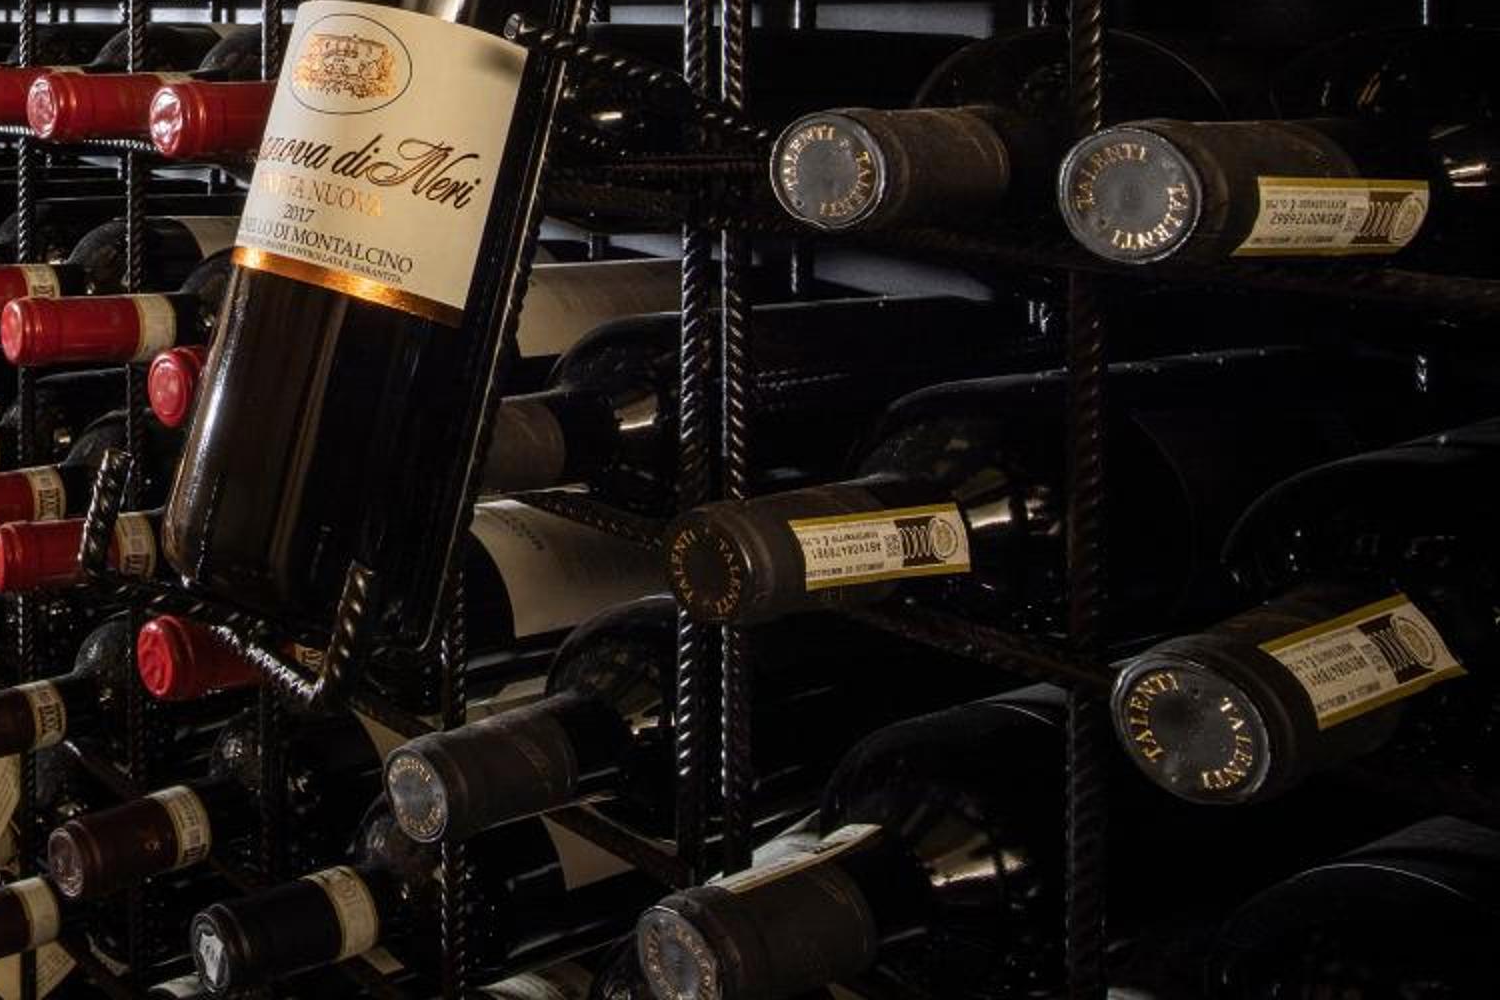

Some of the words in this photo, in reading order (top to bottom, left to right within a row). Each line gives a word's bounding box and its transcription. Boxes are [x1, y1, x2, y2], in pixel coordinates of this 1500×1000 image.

[332, 133, 383, 180] di
[365, 138, 482, 210] Neri
[1076, 143, 1147, 209] TALENTI
[283, 203, 315, 224] 2017
[1111, 182, 1189, 250] TALENTI
[290, 229, 413, 274] MONTALCINO
[1129, 672, 1179, 763] TALENTI
[1201, 697, 1254, 790] TALENTI
